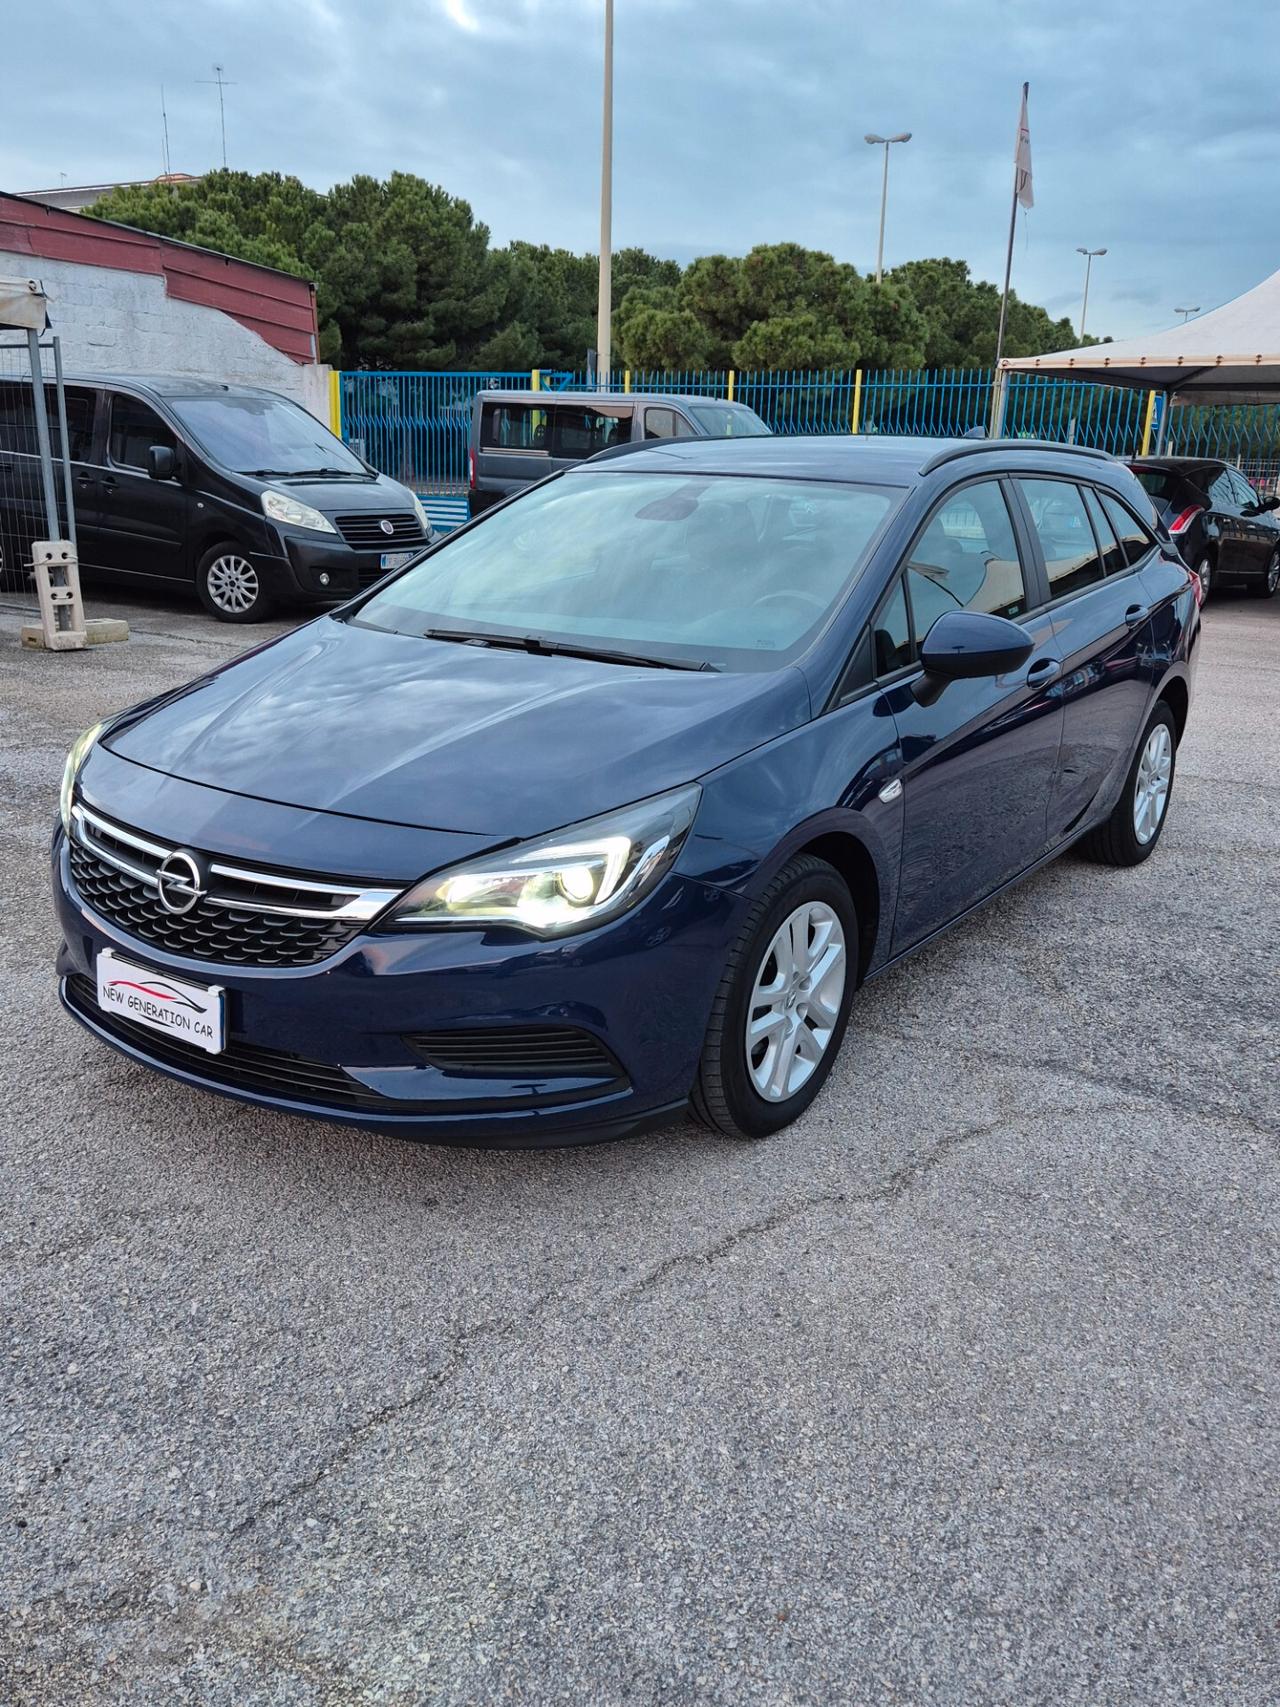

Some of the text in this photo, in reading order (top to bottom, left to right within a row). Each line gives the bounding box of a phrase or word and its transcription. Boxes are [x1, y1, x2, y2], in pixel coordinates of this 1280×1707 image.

[103, 986, 213, 1039] NEW GENERATION CAR
